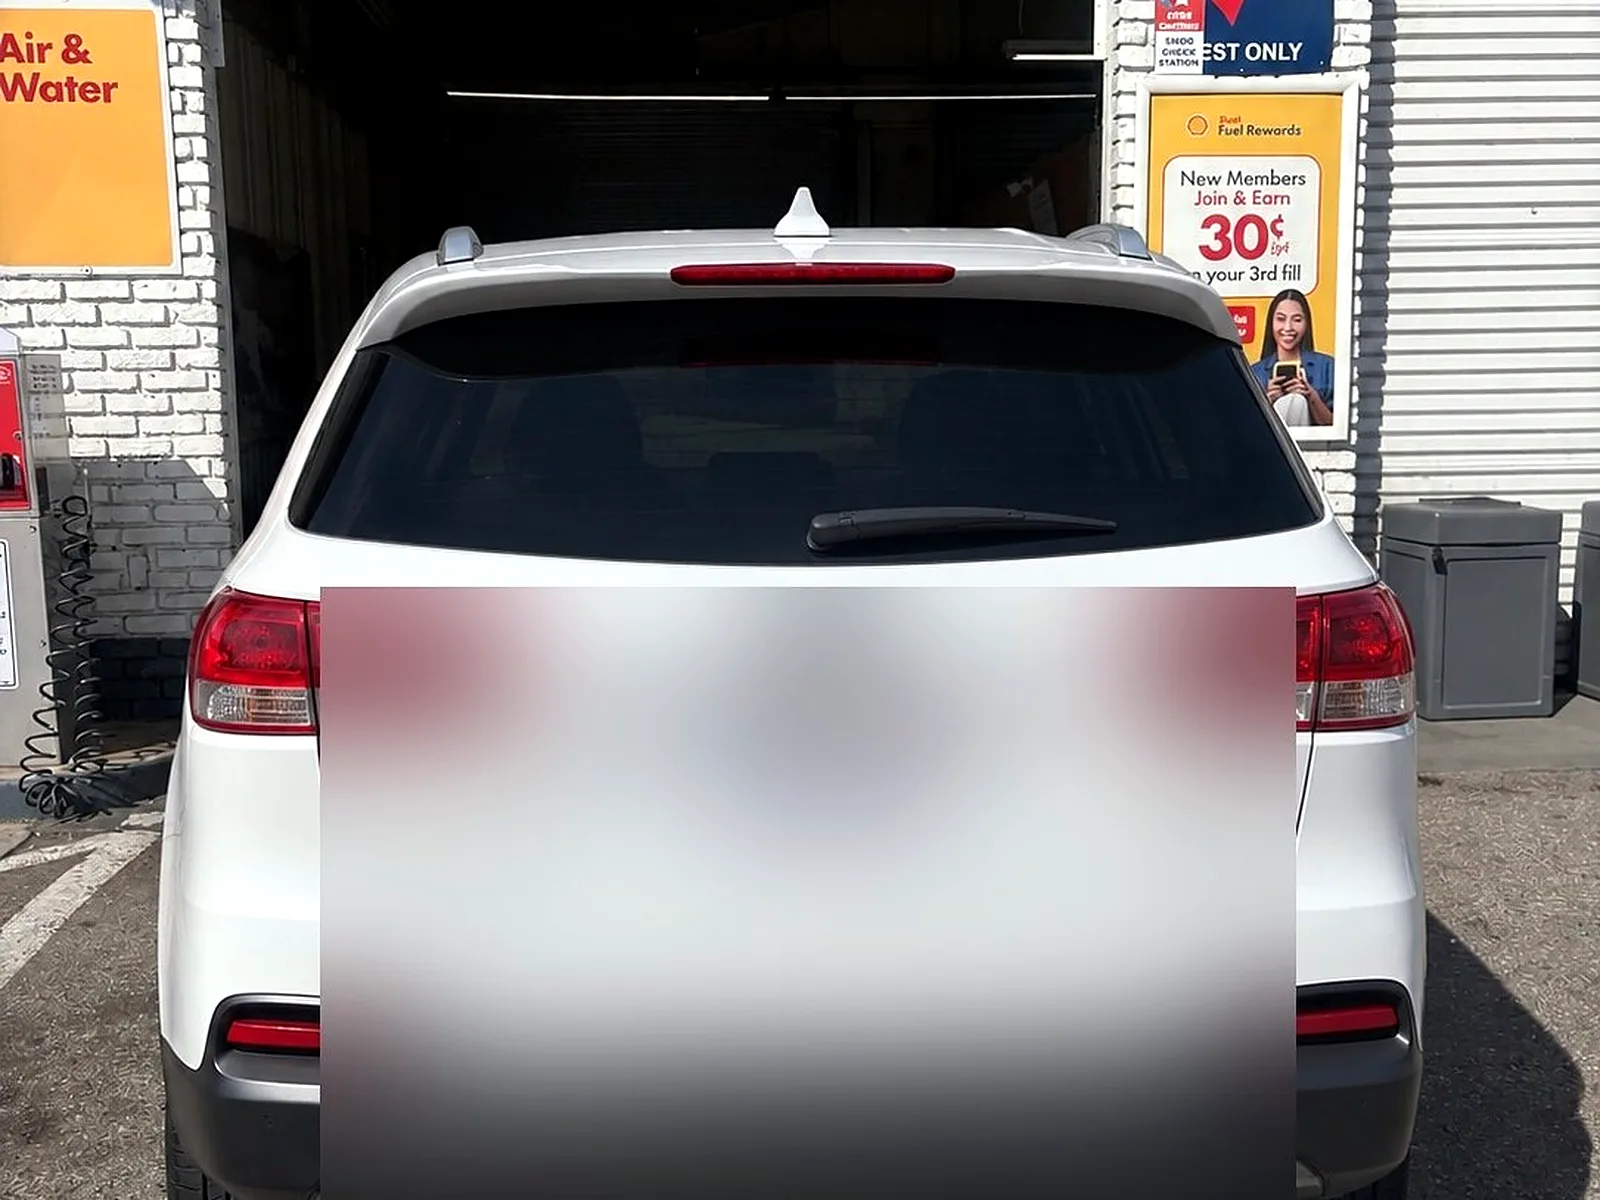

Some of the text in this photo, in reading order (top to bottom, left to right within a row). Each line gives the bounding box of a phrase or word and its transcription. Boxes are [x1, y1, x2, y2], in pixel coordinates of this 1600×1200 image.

[0, 31, 93, 65] Air &
[1203, 42, 1303, 61] EST ONLY
[1158, 59, 1199, 67] STATION
[0, 72, 119, 104] Water
[1218, 124, 1301, 136] Fuel Rewards
[1180, 169, 1306, 186] New Members
[1194, 190, 1291, 206] Join & Earn
[1206, 271, 1245, 286] your
[1250, 264, 1277, 281] 3rd
[1282, 263, 1301, 281] fill
